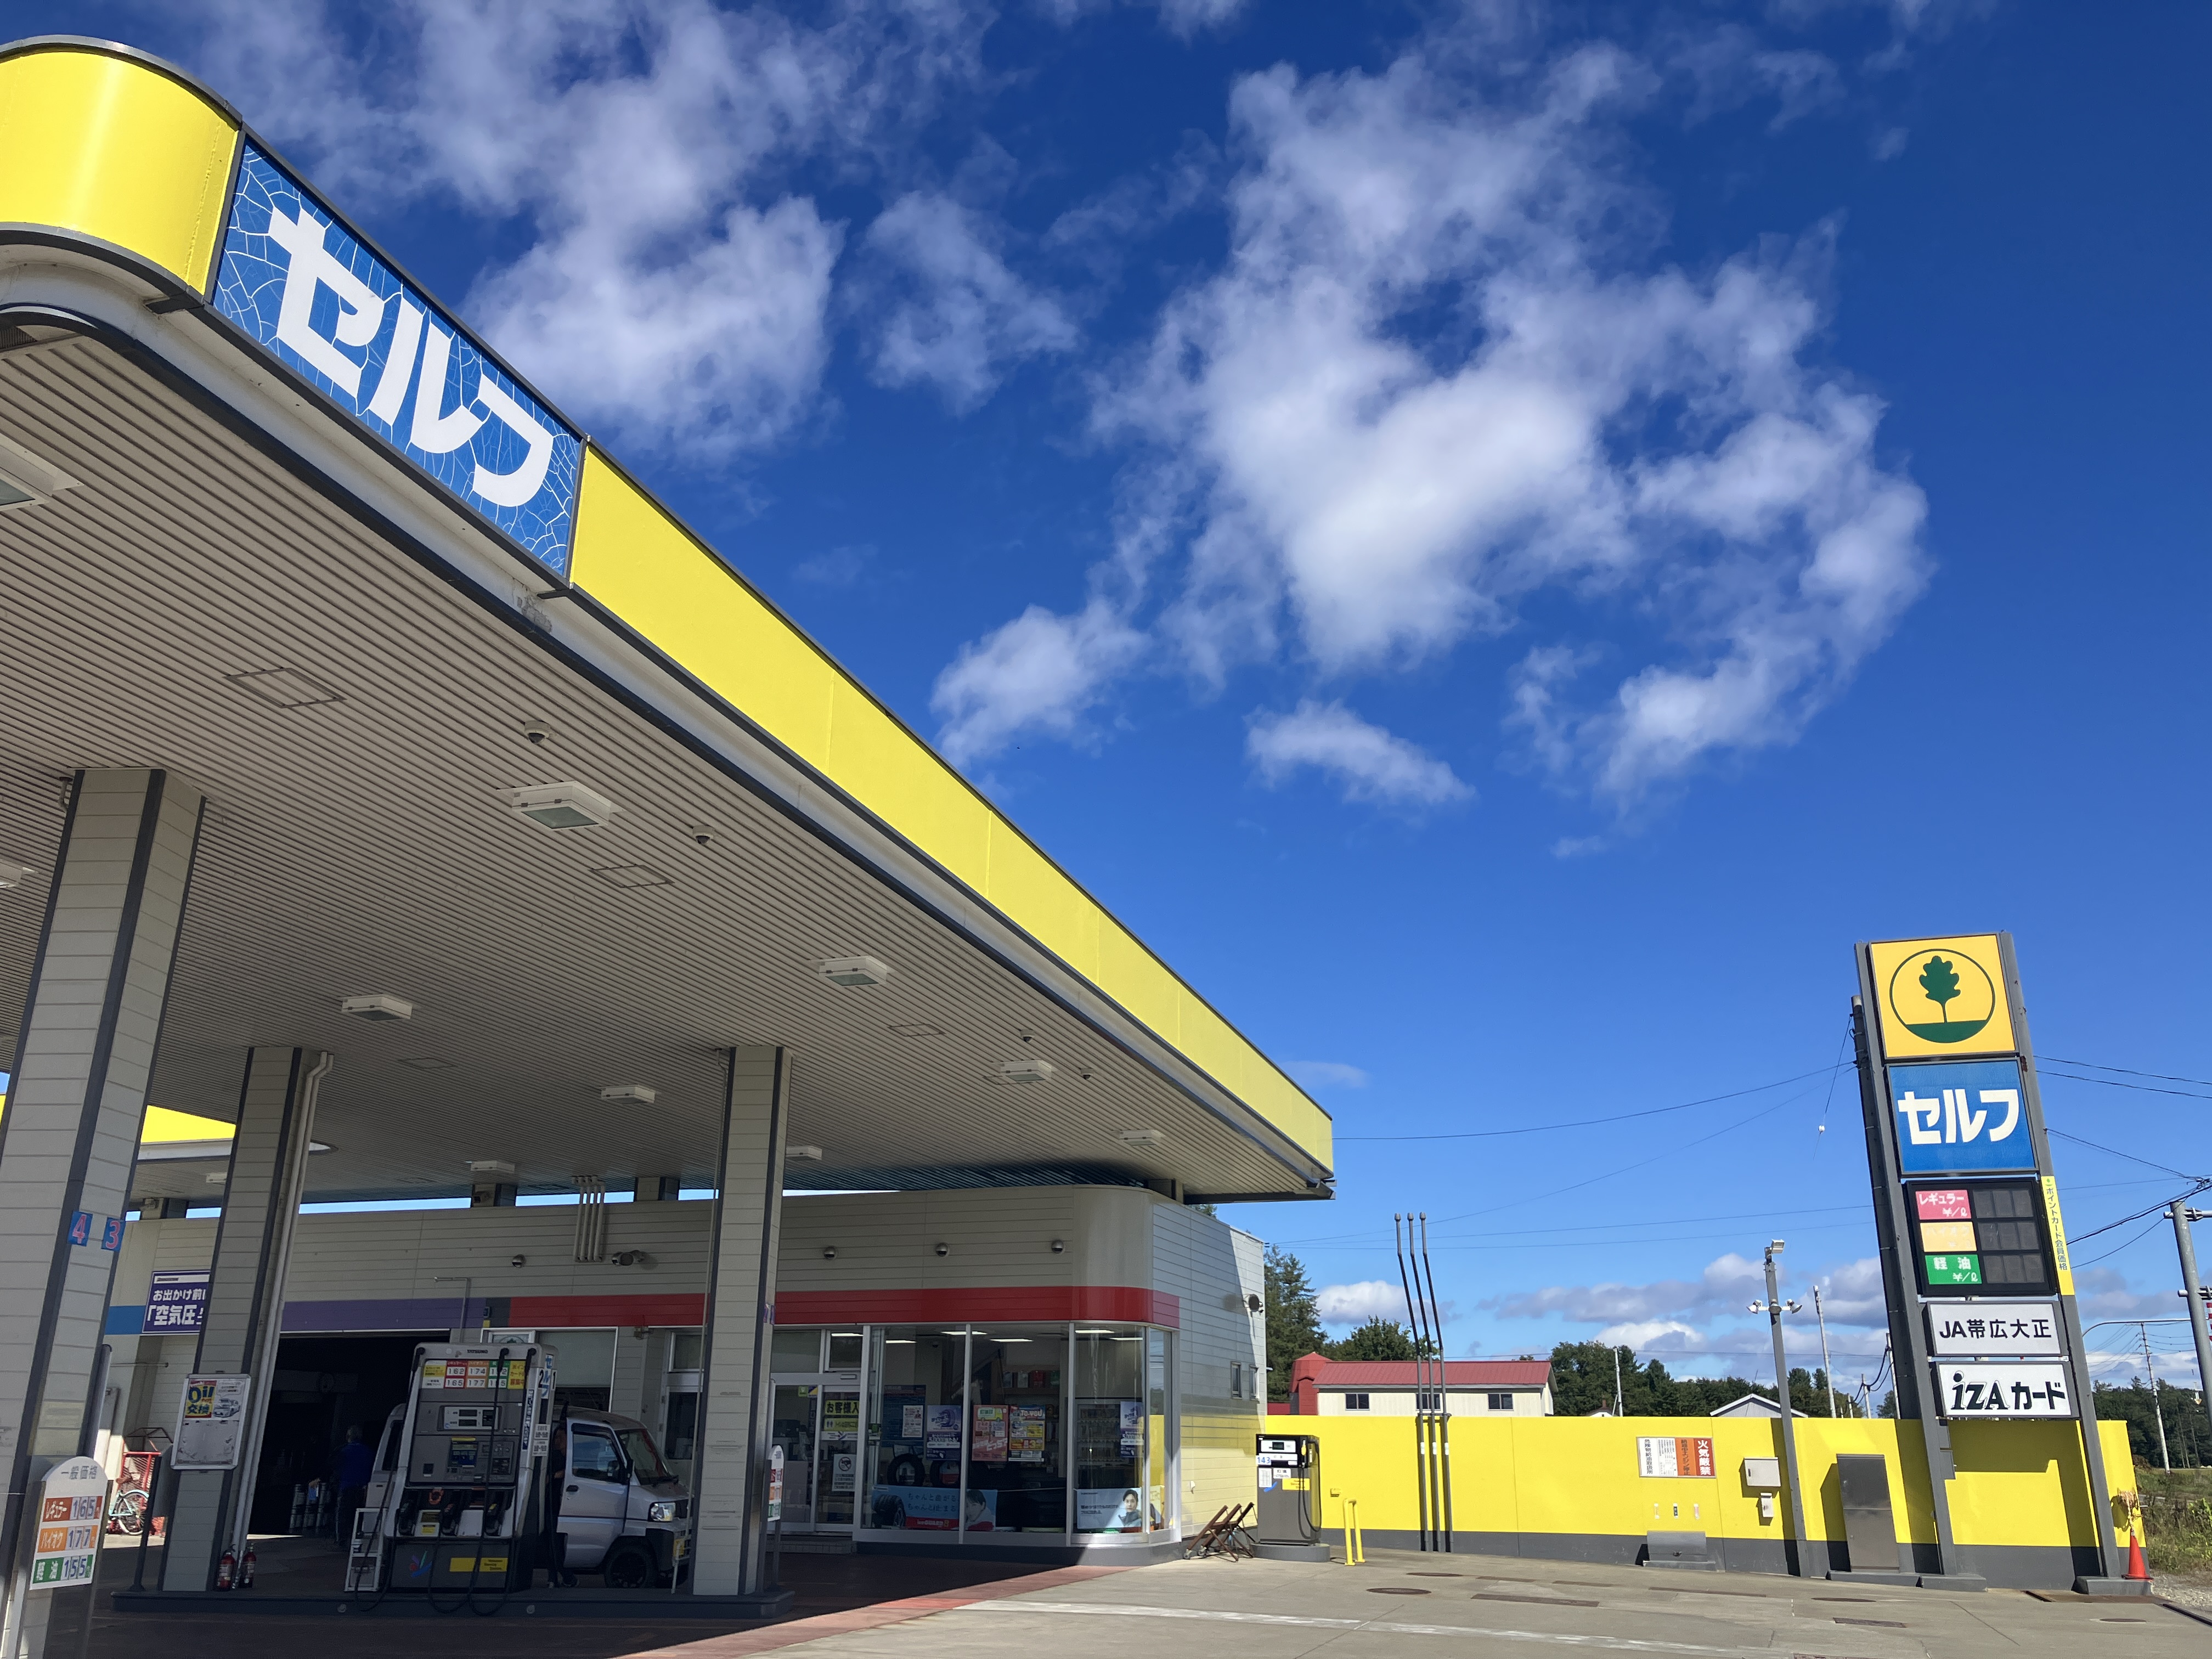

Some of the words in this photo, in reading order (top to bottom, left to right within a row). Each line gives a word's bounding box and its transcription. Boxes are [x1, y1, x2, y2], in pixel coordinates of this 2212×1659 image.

[269, 207, 553, 507] セルフ
[1897, 1088, 2019, 1145] セルフ
[1918, 1193, 1965, 1206] レギュラー
[72, 1214, 87, 1244] 4
[105, 1220, 121, 1249] 3
[2046, 1187, 2068, 1271] ポイントカード会員価格
[1939, 1319, 2052, 1339] JA帯広大正
[552, 1372, 556, 1390] 1
[188, 1386, 214, 1403] Oil
[1697, 1440, 1712, 1475] 火気厳禁
[61, 1465, 98, 1480] 一般価格
[73, 1499, 95, 1517] 165
[69, 1528, 91, 1548] 177
[64, 1558, 86, 1578] 155
